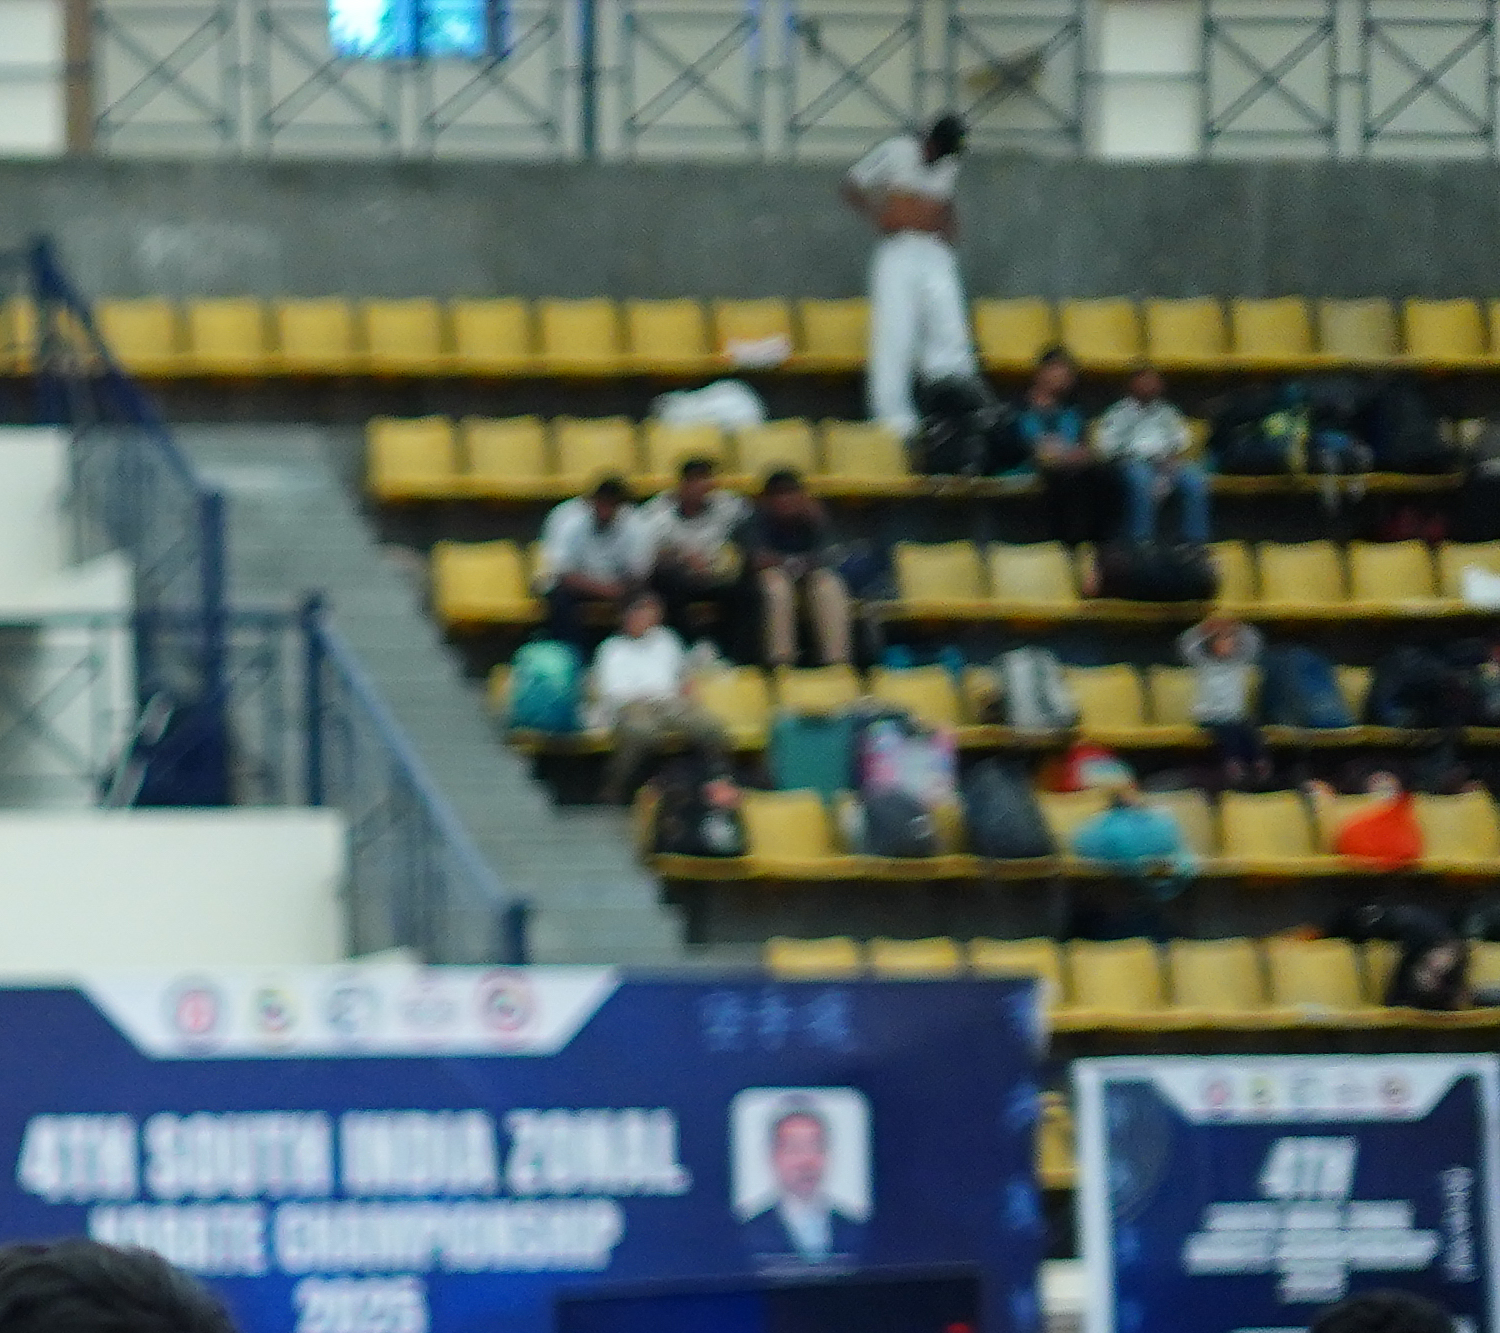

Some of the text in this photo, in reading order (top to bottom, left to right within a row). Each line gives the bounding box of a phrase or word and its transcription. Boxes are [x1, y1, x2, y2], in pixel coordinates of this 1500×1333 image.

[144, 1110, 334, 1201] SOUTH
[339, 1108, 498, 1197] INDIA
[503, 1107, 692, 1197] ZONAL
[272, 1200, 625, 1273] CHAMPIONSHIP
